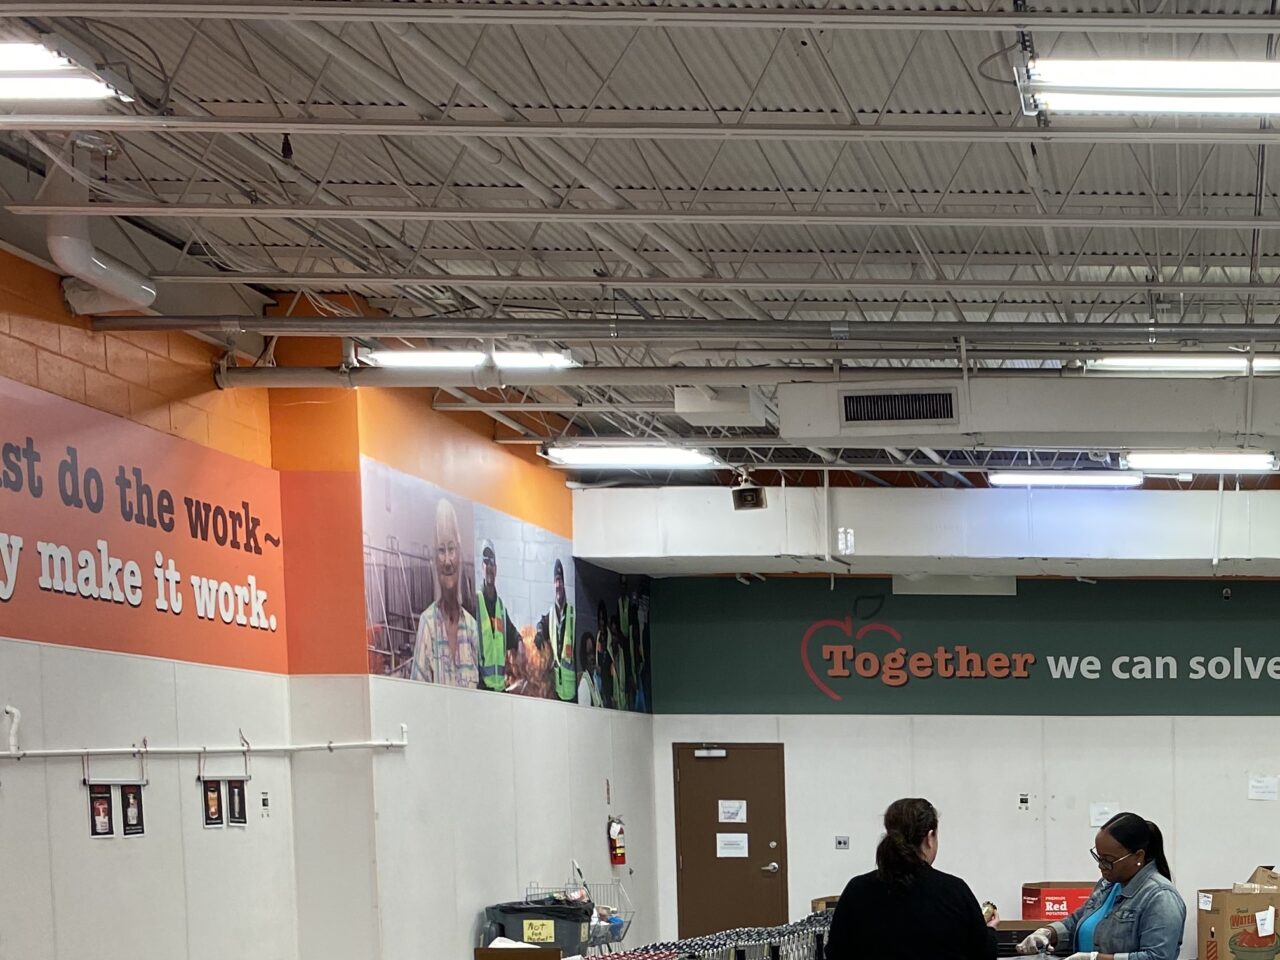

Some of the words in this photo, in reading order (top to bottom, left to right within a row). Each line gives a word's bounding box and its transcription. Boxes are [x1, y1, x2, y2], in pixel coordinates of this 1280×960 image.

[0, 436, 43, 498] st
[58, 446, 104, 513] do
[115, 465, 175, 532] the
[37, 539, 143, 607] make
[153, 550, 183, 615] it
[190, 575, 278, 632] work.
[822, 645, 1036, 686] Together
[1046, 656, 1101, 680] we
[1111, 656, 1177, 680] can
[1045, 901, 1068, 911] Red
